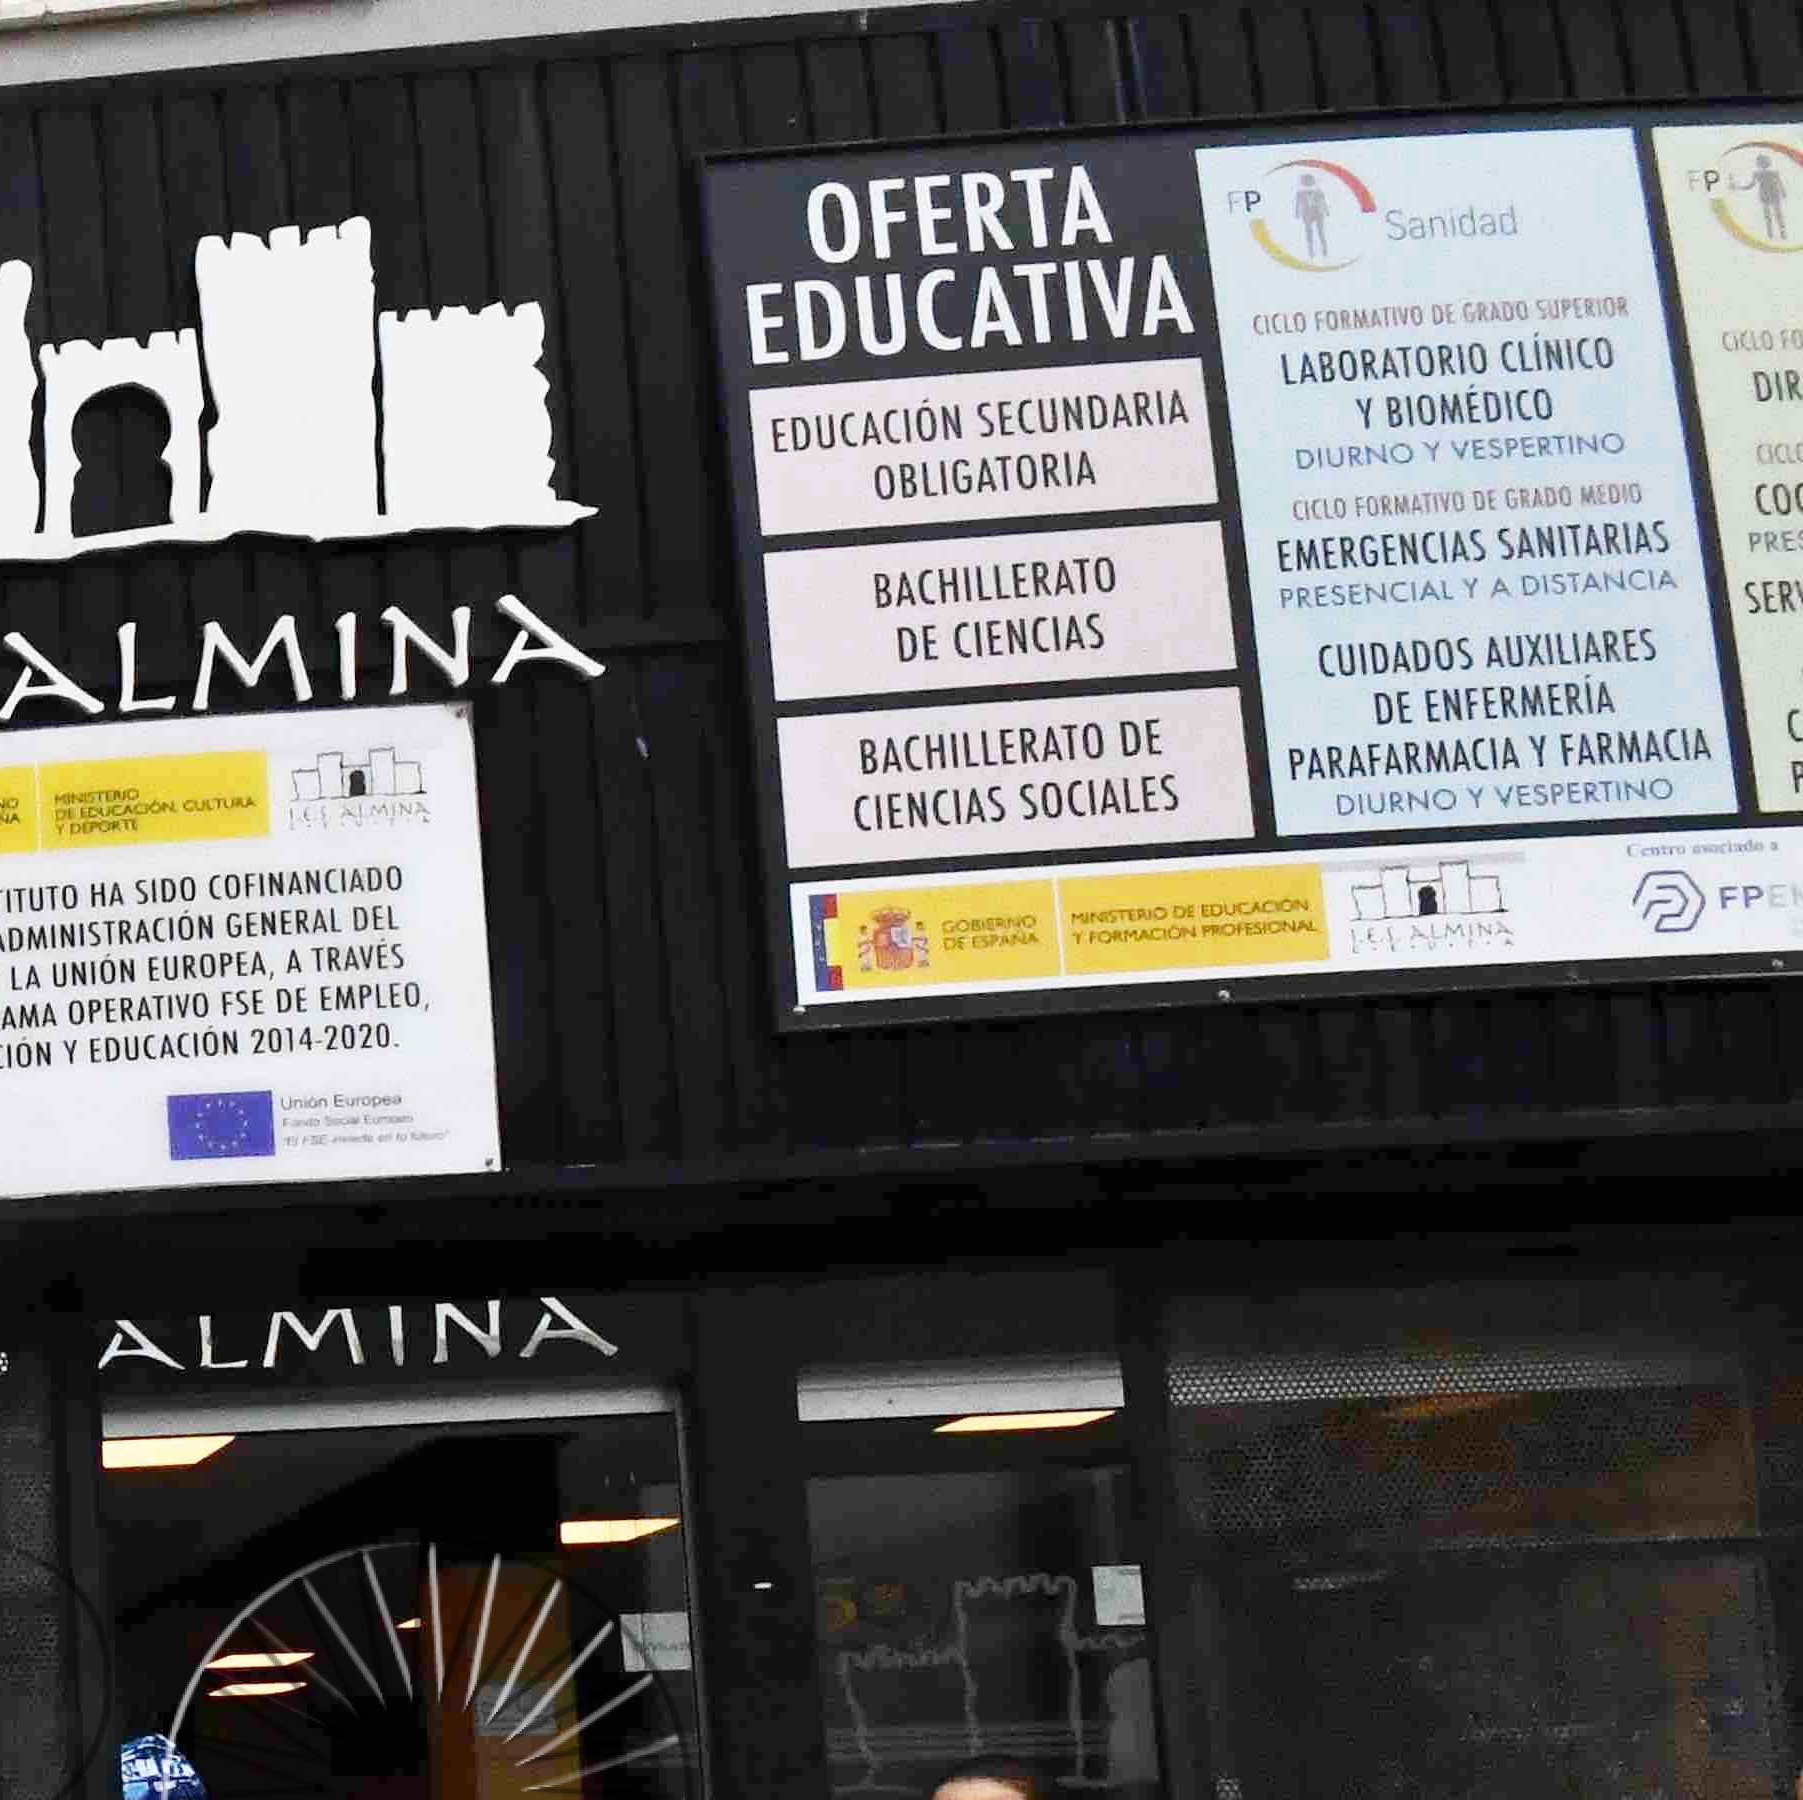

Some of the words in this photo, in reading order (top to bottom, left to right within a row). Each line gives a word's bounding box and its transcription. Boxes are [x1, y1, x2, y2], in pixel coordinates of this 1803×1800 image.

[807, 165, 1113, 264] OFERTA
[1227, 190, 1261, 215] FP
[1384, 204, 1519, 241] Sanidad
[745, 254, 1195, 365] EDUCATIVA
[1252, 311, 1307, 337] CICLO
[1314, 305, 1424, 332] FORMATIVO
[1431, 303, 1456, 326] DE
[1462, 300, 1530, 324] GRADO
[1535, 296, 1630, 321] SUPERIOR
[1280, 342, 1488, 386] LABORATORIO
[1500, 332, 1614, 373] CLÍNICO
[1722, 329, 1774, 352] CICLO
[770, 399, 963, 453] EDUCACIÓN
[976, 389, 1190, 438] SECUNDARIA
[1354, 397, 1372, 430] Y
[1385, 384, 1553, 428] BIOMÉDICO
[1295, 442, 1415, 470] DIURNO
[1422, 441, 1440, 462] Y
[1450, 432, 1625, 461] VESPERTINO
[874, 450, 1097, 501] OBLIGATORIA
[1292, 497, 1347, 521] CICLO
[1354, 490, 1466, 518] FORMATIVO
[1472, 489, 1497, 512] DE
[1504, 484, 1572, 510] GRADO
[1580, 482, 1643, 505] MEDIO
[1276, 528, 1487, 573] EMERGENCIAS
[1497, 520, 1670, 561] SANITARIAS
[874, 556, 1116, 609] BACHILLERATO
[1279, 579, 1454, 609] PRESENCIAL
[1462, 577, 1479, 599] Y
[1490, 576, 1511, 598] A
[1520, 568, 1678, 597] DISTANCIA
[896, 624, 939, 663] DE
[953, 613, 1105, 659] CIENCIAS
[1318, 637, 1474, 678] CUIDADOS
[1486, 628, 1657, 669] AUXILIARES
[1373, 690, 1414, 726] DE
[1424, 675, 1616, 723] ENFERMERÍA
[859, 722, 1104, 775] BACHILLERATO
[1119, 718, 1163, 757] DE
[1288, 736, 1521, 781] PARAFARMACIA
[1528, 735, 1547, 768] Y
[1559, 727, 1712, 767] FARMACIA
[53, 788, 139, 804] MINISTERIO
[55, 807, 76, 821] DE
[182, 796, 258, 813] CULTURA
[853, 785, 1006, 832] CIENCIAS
[1019, 773, 1179, 821] SOCIALES
[1336, 788, 1458, 817] DIURNO
[1466, 786, 1484, 809] Y
[1493, 777, 1674, 809] VESPERTINO
[69, 818, 139, 835] DEPORTE
[90, 881, 124, 908] HA
[135, 876, 196, 905] SIDO
[208, 865, 403, 901] COFINANCIADO
[226, 907, 342, 939] GENERAL
[352, 905, 399, 932] DEL
[941, 914, 1037, 934] GOBIERNO
[1071, 906, 1169, 925] MINISTERIO
[1172, 904, 1196, 919] DE
[1200, 898, 1310, 918] EDUCACIÓN
[1088, 922, 1197, 945] FORMACIÓN
[1202, 918, 1318, 938] PROFESIONAL
[1410, 920, 1515, 940] ALMINA
[943, 936, 967, 952] DE
[971, 930, 1039, 950] ESPAÑA
[10, 964, 41, 991] LA
[52, 955, 136, 988] UNIÓN
[147, 951, 274, 982] EUROPEA,
[286, 949, 302, 974] A
[310, 943, 404, 973] TRAVÉS
[68, 992, 209, 1026] OPERATIVO
[221, 989, 264, 1017] FSE
[276, 987, 308, 1014] DE
[319, 981, 429, 1012] EMPLEO,
[63, 1039, 78, 1065] Y
[89, 1030, 239, 1064] EDUCACIÓN
[250, 1022, 399, 1055] 2014-2020.
[280, 1095, 328, 1111] Unión
[332, 1093, 403, 1109] Europea
[97, 1296, 619, 1370] ALMINA
